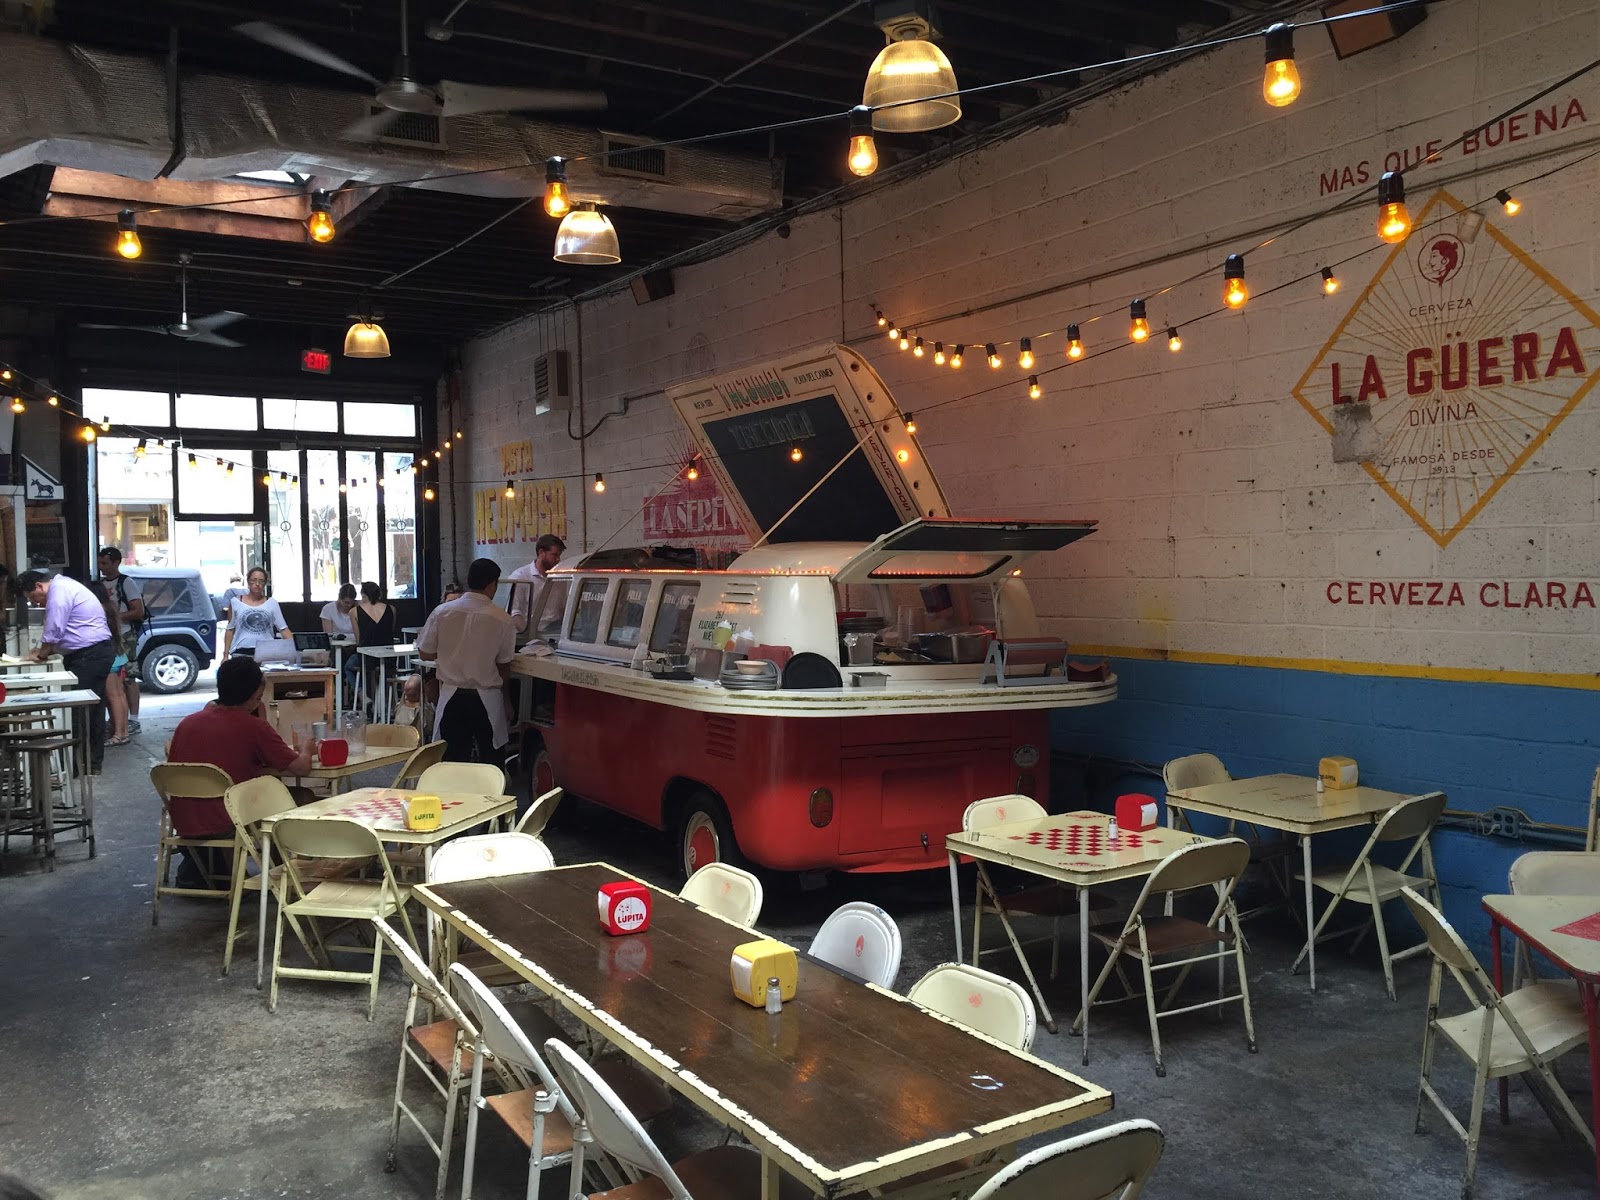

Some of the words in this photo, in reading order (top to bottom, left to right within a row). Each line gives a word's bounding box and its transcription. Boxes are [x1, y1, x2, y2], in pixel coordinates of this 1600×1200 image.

[1320, 160, 1370, 197] MAS
[1384, 139, 1443, 174] QUE
[1462, 98, 1587, 155] BUENA
[1409, 297, 1473, 318] CERVEZA
[307, 352, 329, 370] EXIT
[1331, 354, 1387, 405] LA
[1409, 402, 1478, 427] DIVINA
[1393, 451, 1446, 468] FAMOSA
[1453, 448, 1495, 462] DESDE
[1326, 582, 1465, 606] CERVEZA
[1480, 582, 1597, 608] CLARA
[699, 620, 719, 630] ELIZABET
[617, 913, 644, 924] LUPITA
